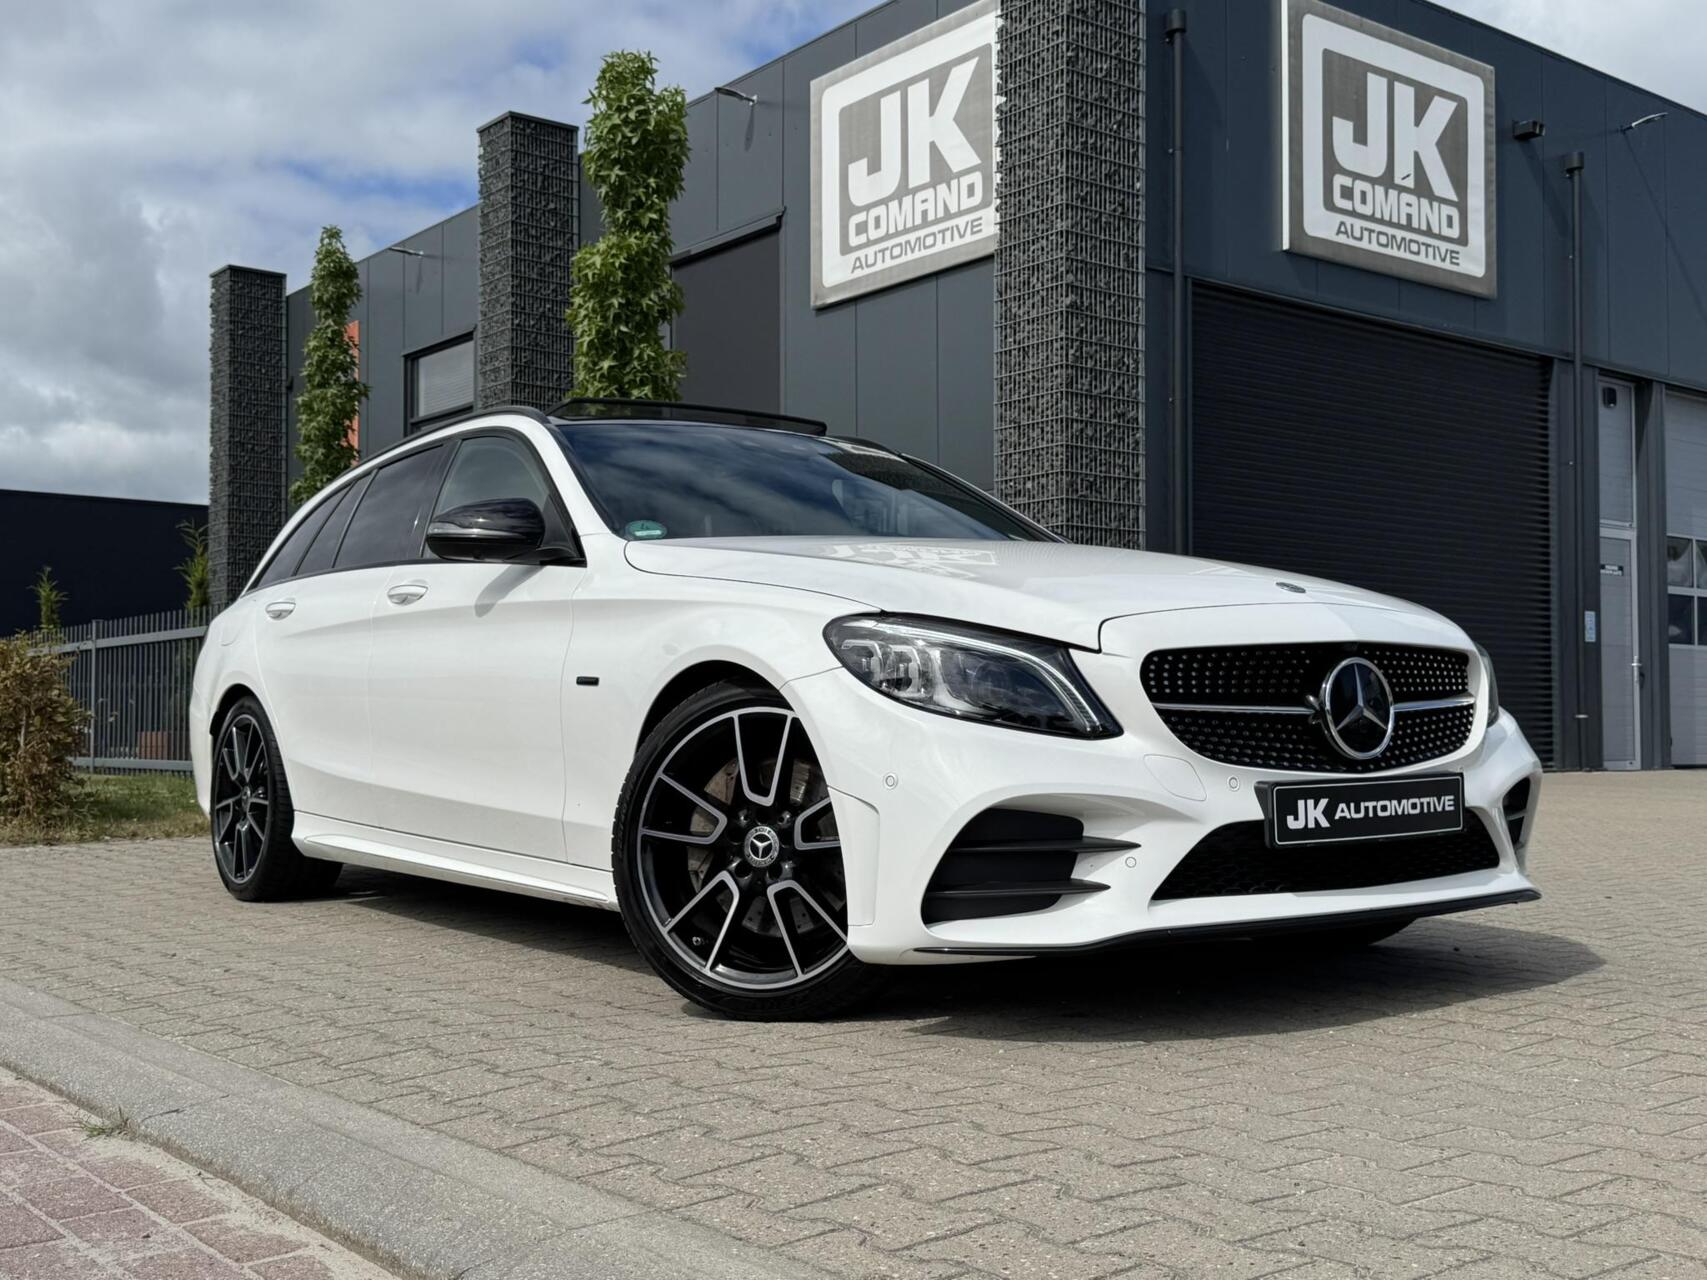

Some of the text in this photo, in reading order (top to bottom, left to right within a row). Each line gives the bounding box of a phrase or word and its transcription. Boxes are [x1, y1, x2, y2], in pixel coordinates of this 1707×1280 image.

[848, 56, 982, 207] JK
[1332, 71, 1459, 202] JK
[849, 171, 983, 247] COMAND
[1332, 173, 1460, 239] COMAND
[851, 217, 983, 274] AUTOMOTIVE
[1335, 220, 1460, 266] AUTOMOTIVE
[1286, 795, 1455, 829] JK AUTOMOTIVE
